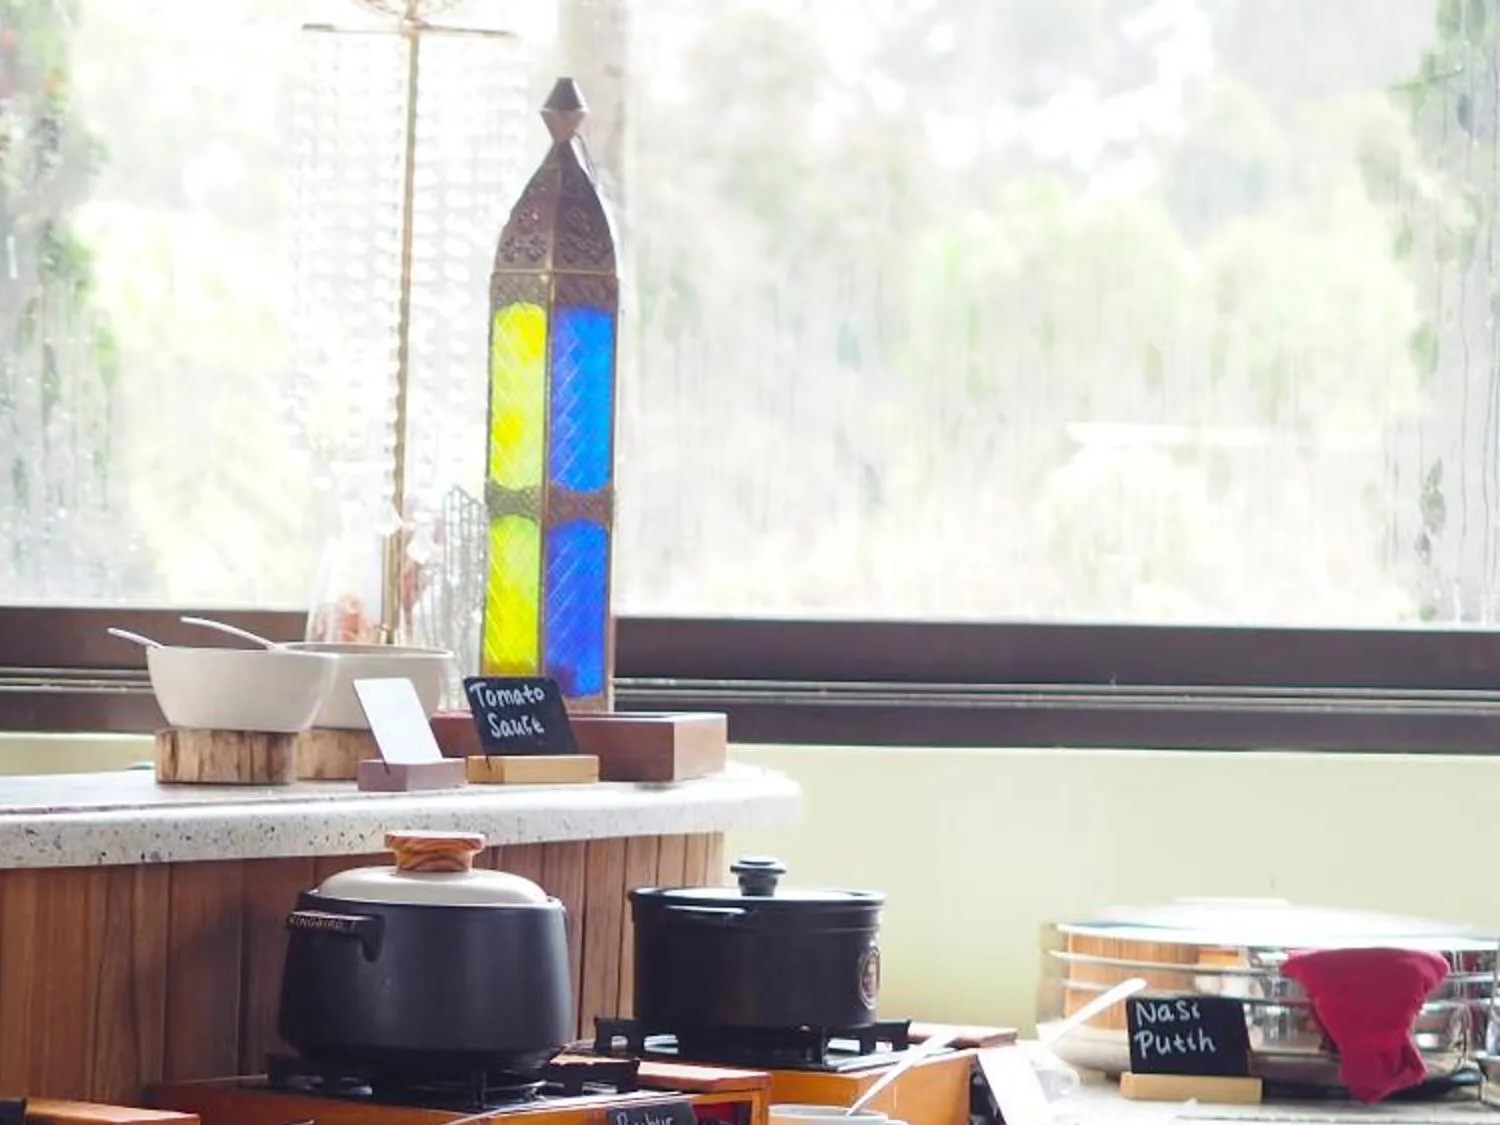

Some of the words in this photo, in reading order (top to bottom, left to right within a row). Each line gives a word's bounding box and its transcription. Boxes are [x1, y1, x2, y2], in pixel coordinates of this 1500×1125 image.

[468, 681, 546, 709] Tomato
[1134, 999, 1201, 1027] Nasi
[1133, 1027, 1217, 1060] Putih
